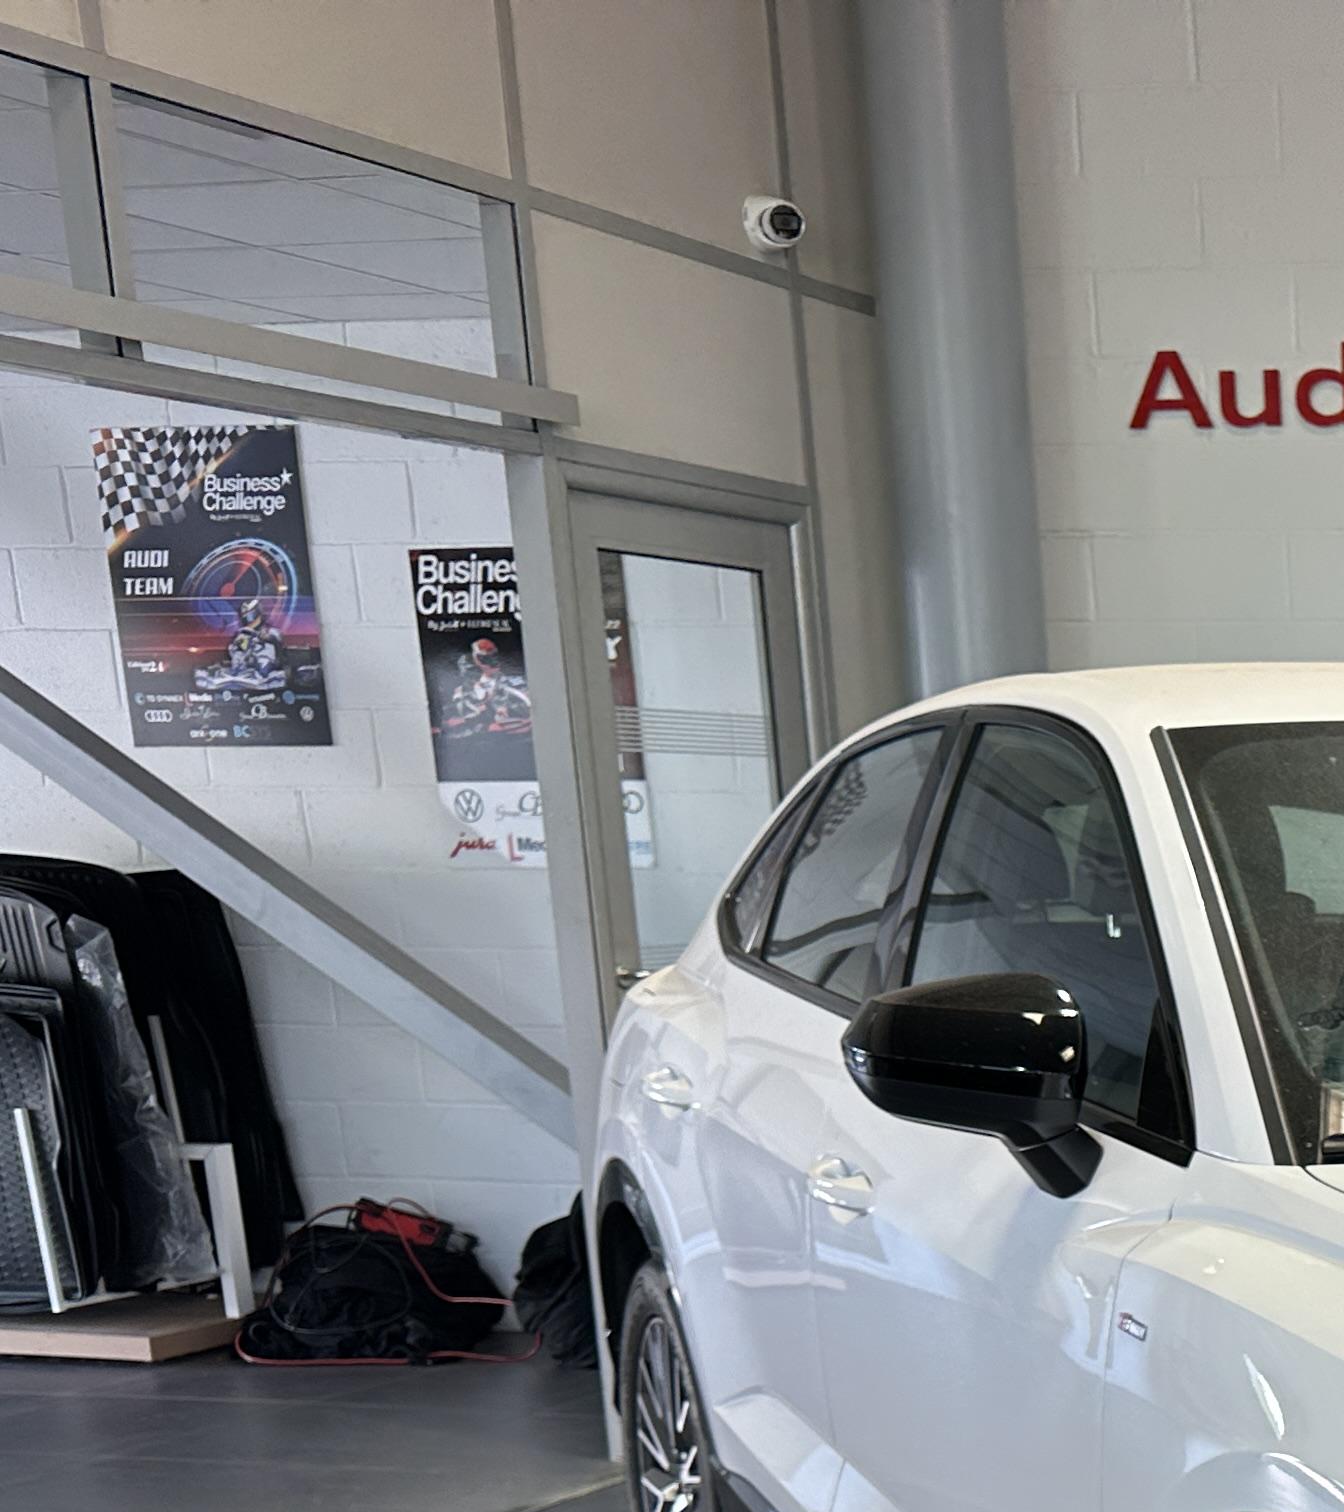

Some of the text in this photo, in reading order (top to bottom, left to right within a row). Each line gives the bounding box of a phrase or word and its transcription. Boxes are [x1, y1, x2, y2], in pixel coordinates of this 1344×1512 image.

[203, 473, 281, 493] Business
[202, 492, 286, 516] Challenge
[123, 549, 170, 569] AUDI
[417, 554, 519, 585] Busine
[122, 577, 174, 596] TEAM
[415, 583, 521, 620] Challen
